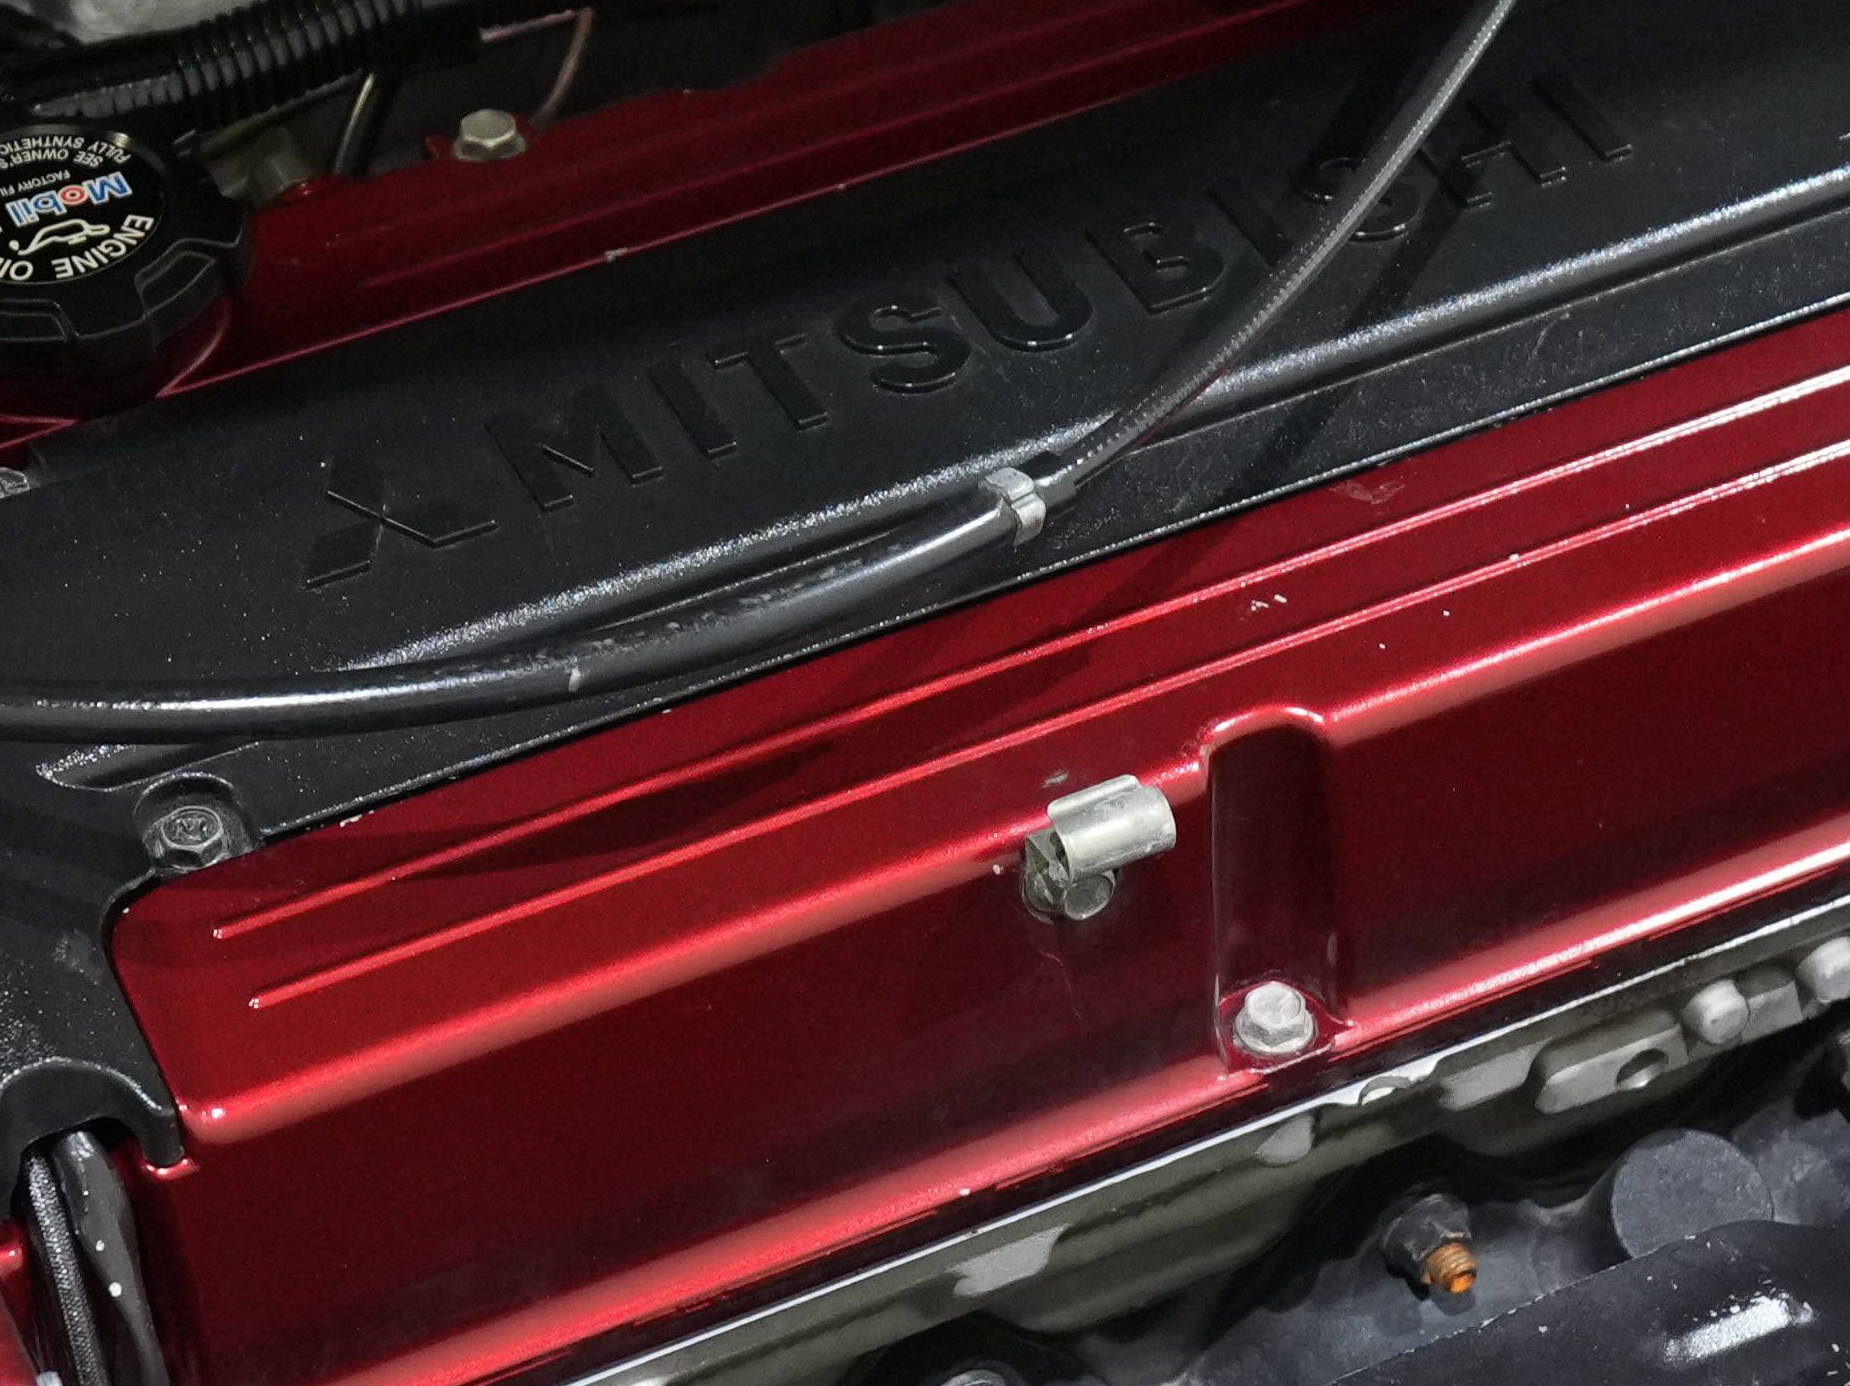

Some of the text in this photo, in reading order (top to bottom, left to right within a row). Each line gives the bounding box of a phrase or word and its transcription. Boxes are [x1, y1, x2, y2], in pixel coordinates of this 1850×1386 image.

[73, 150, 104, 168] SEE
[88, 139, 131, 164] FULLY
[4, 170, 134, 228] Mobil
[17, 168, 71, 193] FACTORY
[51, 213, 155, 280] ENGINE
[484, 67, 1635, 515] MITSUBISHI
